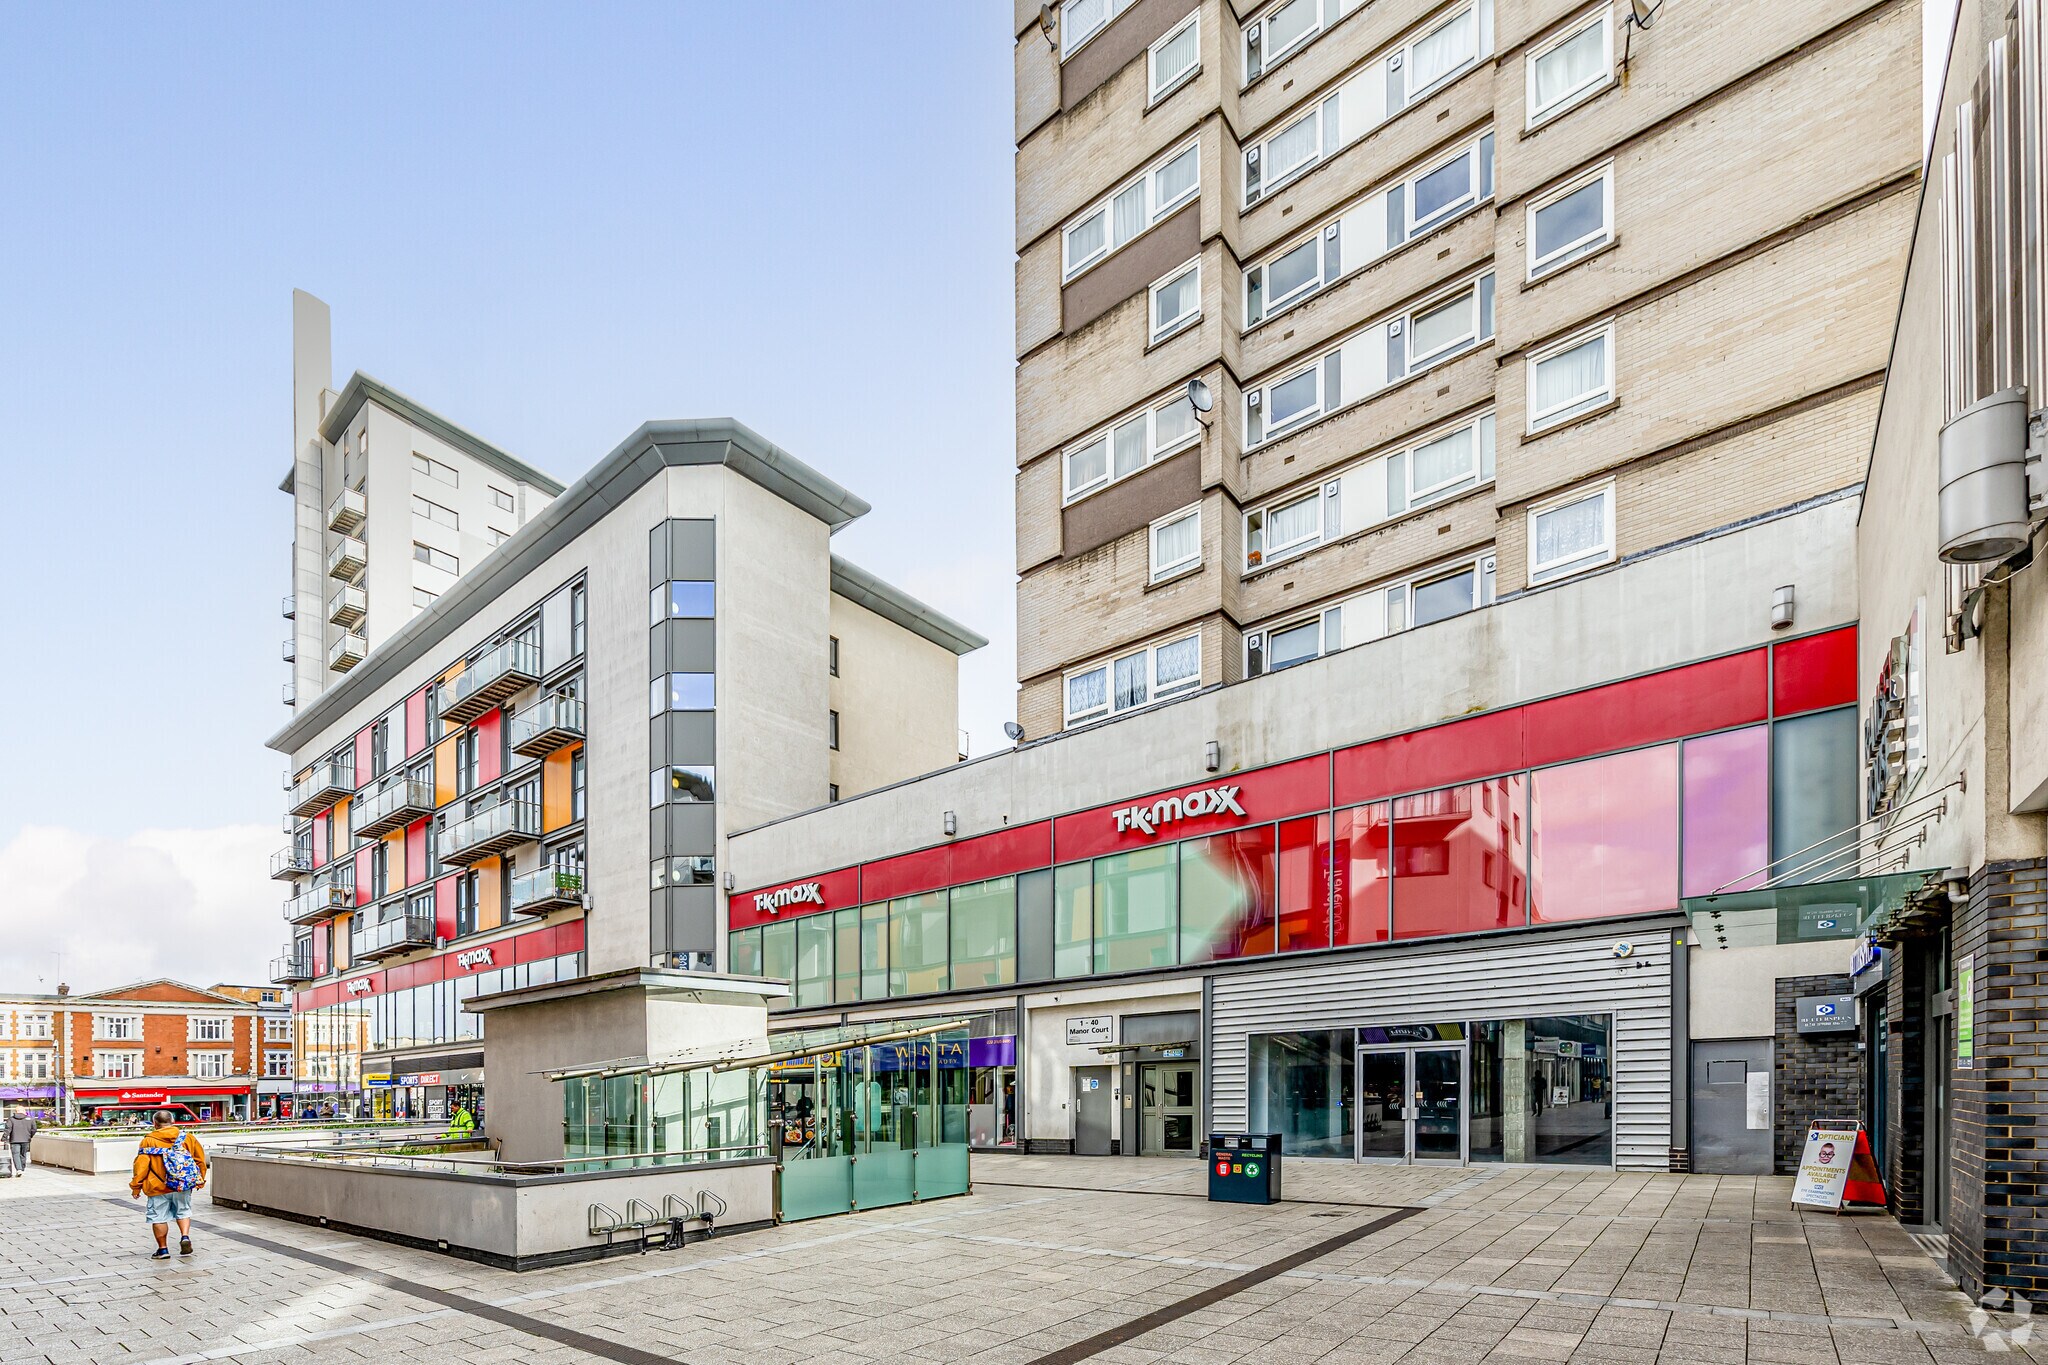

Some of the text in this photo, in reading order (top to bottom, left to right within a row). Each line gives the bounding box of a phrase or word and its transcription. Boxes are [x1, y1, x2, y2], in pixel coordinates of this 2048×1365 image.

[400, 1074, 440, 1085] SPORTS DIRECT
[1801, 1166, 1846, 1174] APPOINTMENTS
